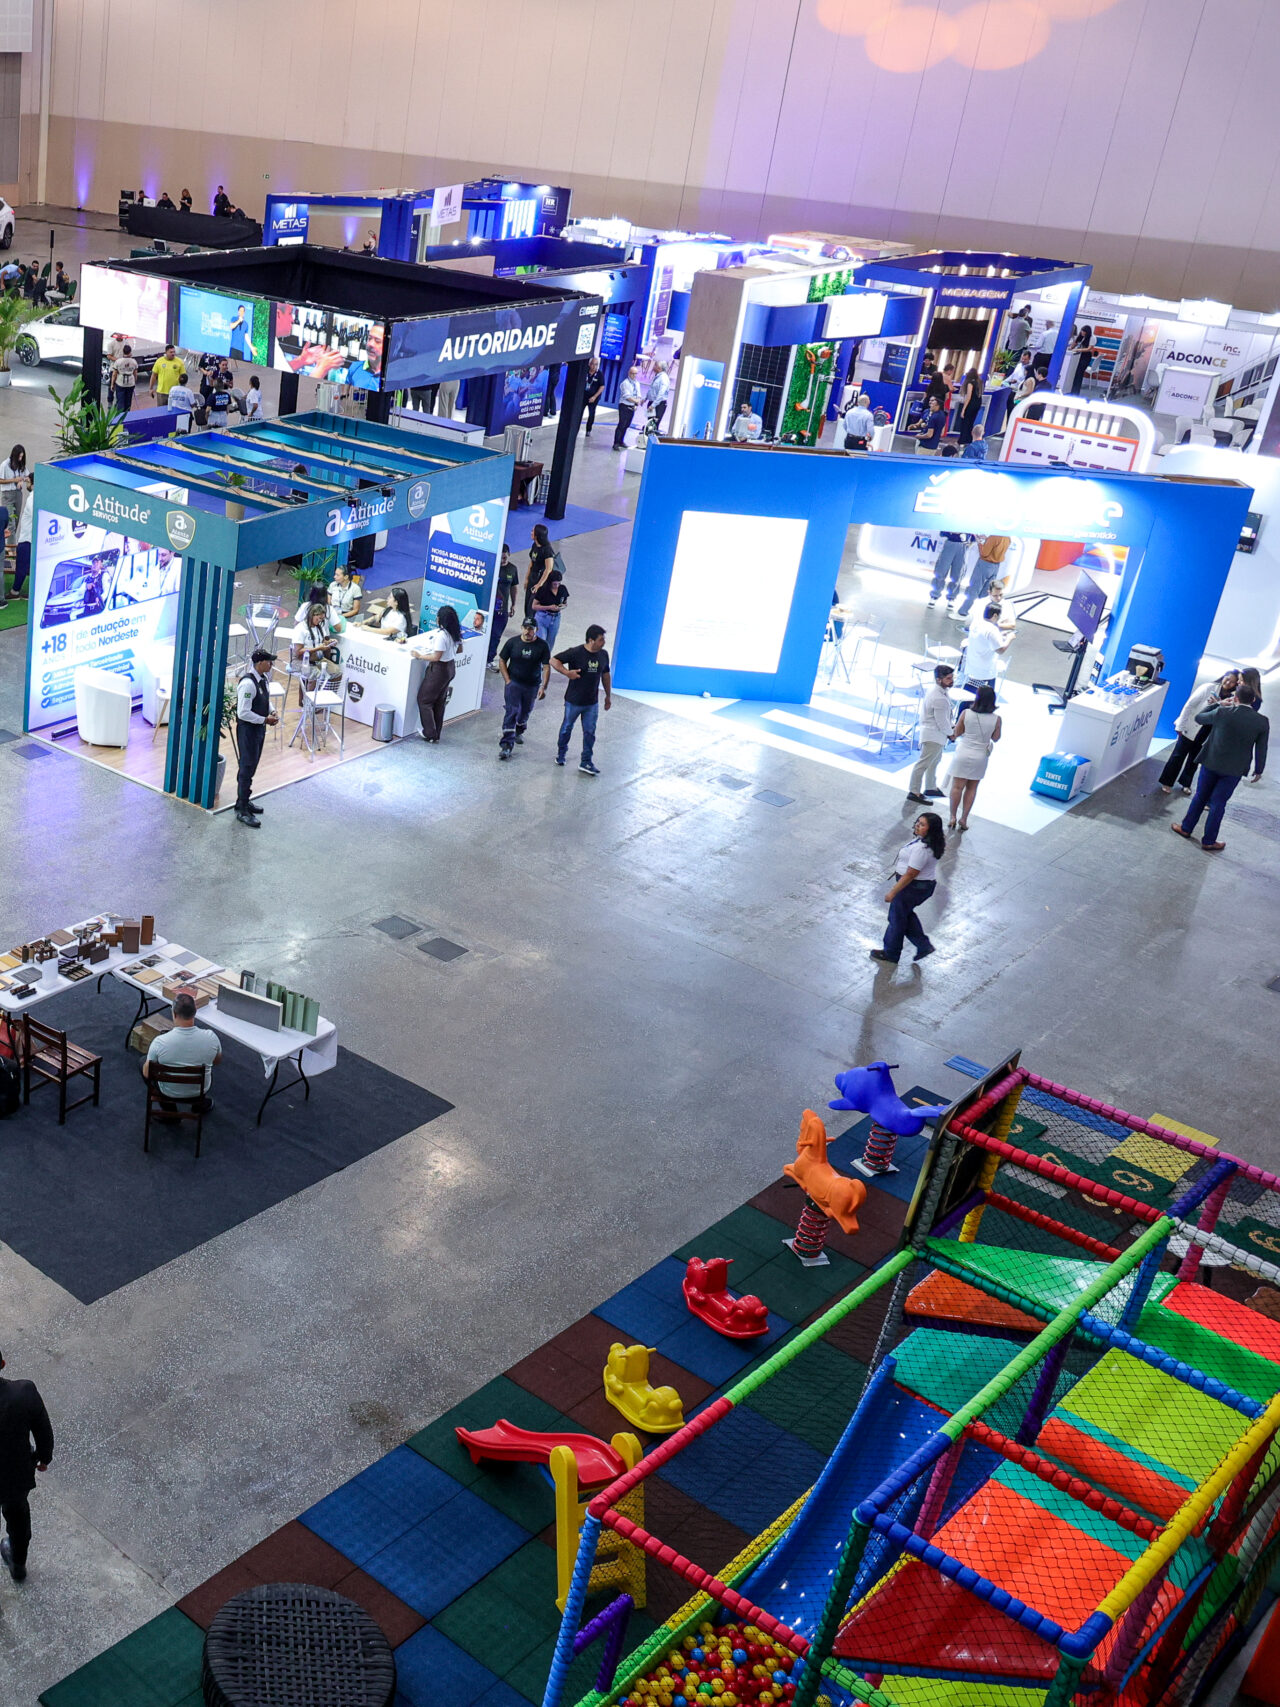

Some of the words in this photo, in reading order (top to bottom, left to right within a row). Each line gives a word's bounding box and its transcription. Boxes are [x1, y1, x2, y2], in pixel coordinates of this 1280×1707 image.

[272, 218, 307, 230] METAS
[438, 322, 558, 363] AUTORIDADE
[1167, 350, 1228, 369] ADCONCE
[1171, 392, 1200, 402] ADCONCE
[92, 493, 148, 524] Atitude
[92, 511, 119, 524] SERVIÇOS
[347, 498, 394, 523] Atitude
[45, 534, 64, 544] Atitude
[462, 526, 494, 541] Atitude
[430, 554, 487, 577] TERCEIRIZAÇÃO
[431, 547, 449, 557] NOSSA
[449, 551, 477, 565] SOLUÇÕES
[437, 565, 455, 577] ALTO
[455, 569, 484, 585] PADRÃO
[76, 628, 88, 641] de
[91, 617, 130, 638] atuação
[131, 614, 146, 626] em
[41, 633, 68, 654] +18
[98, 628, 139, 648] Nordeste
[345, 663, 366, 674] SERVIÇOS
[346, 653, 387, 676] Atitude
[1045, 771, 1062, 781] TENTE
